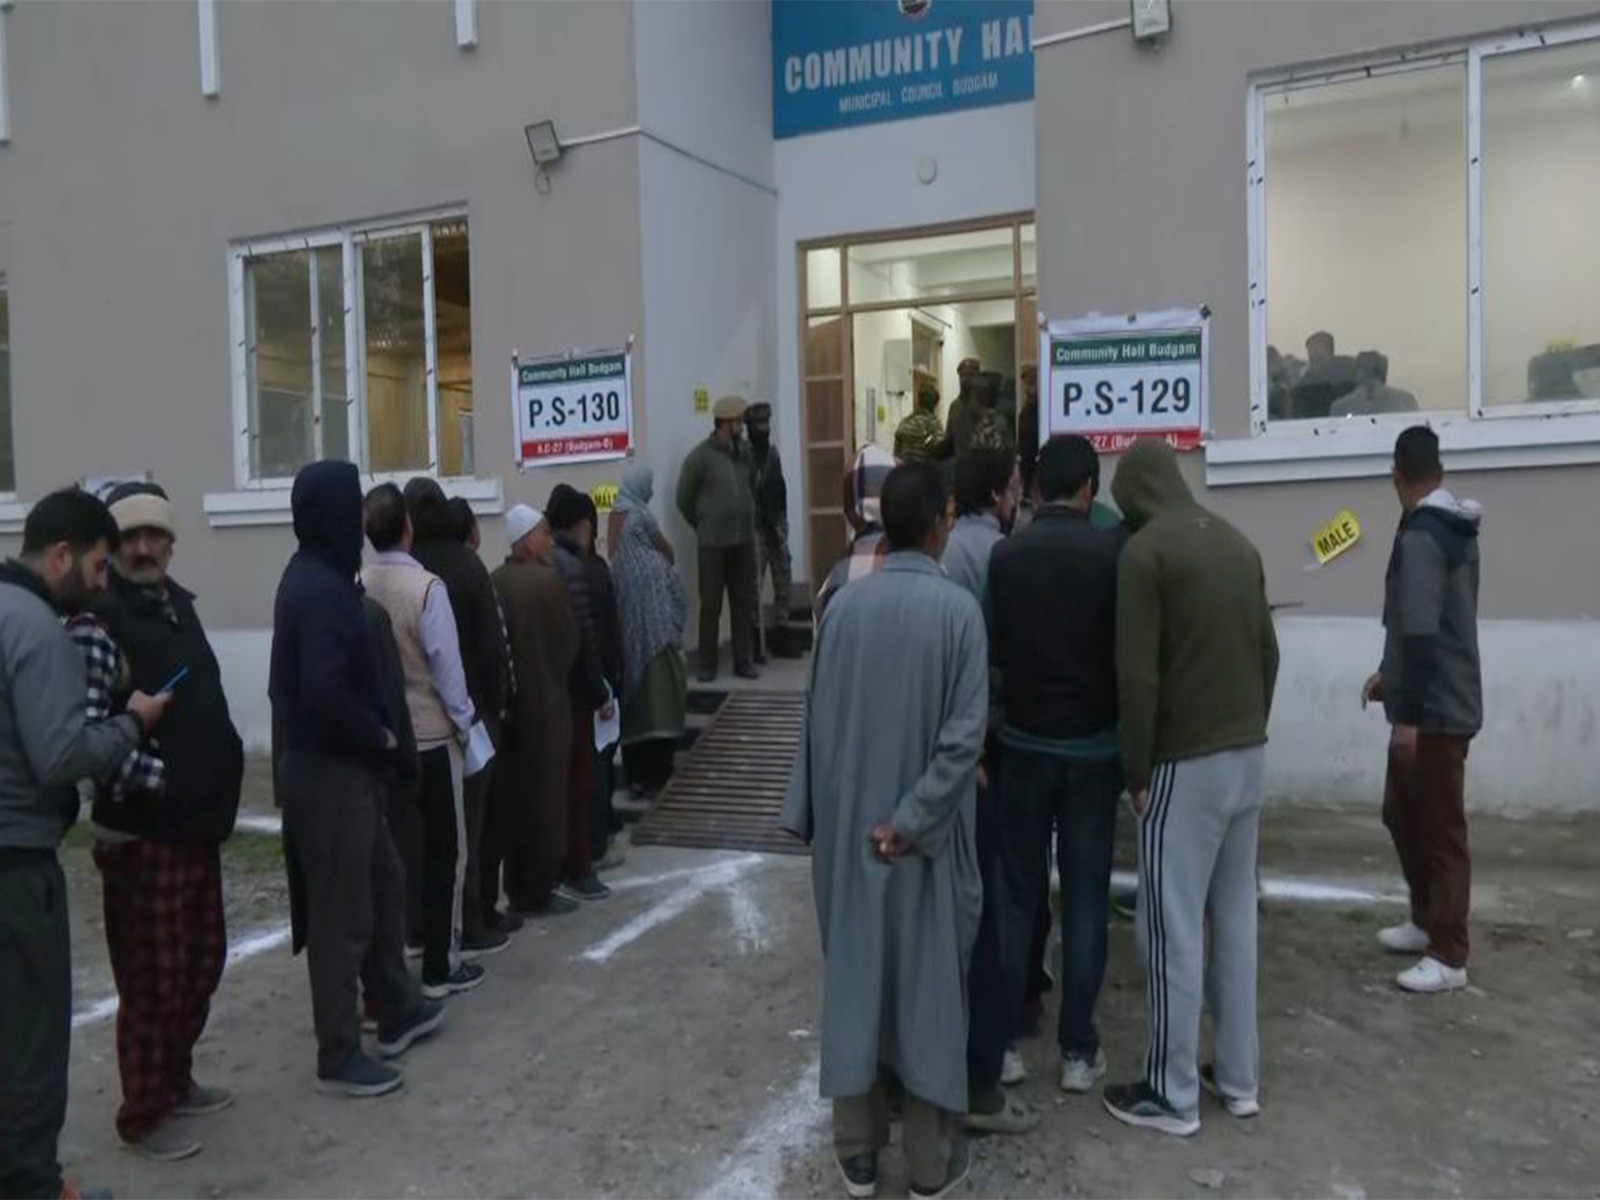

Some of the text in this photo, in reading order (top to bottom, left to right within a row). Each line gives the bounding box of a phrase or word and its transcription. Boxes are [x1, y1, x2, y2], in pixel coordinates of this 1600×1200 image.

[784, 27, 963, 93] COMMUNITY
[839, 90, 891, 113] MUNICIPAL
[901, 82, 944, 104] COUNCIL
[1056, 342, 1197, 362] Community Hall Budgam
[522, 367, 567, 383] Community
[529, 391, 620, 428] P.S-130
[1063, 377, 1191, 417] P.S-129
[1317, 521, 1356, 557] MALE
